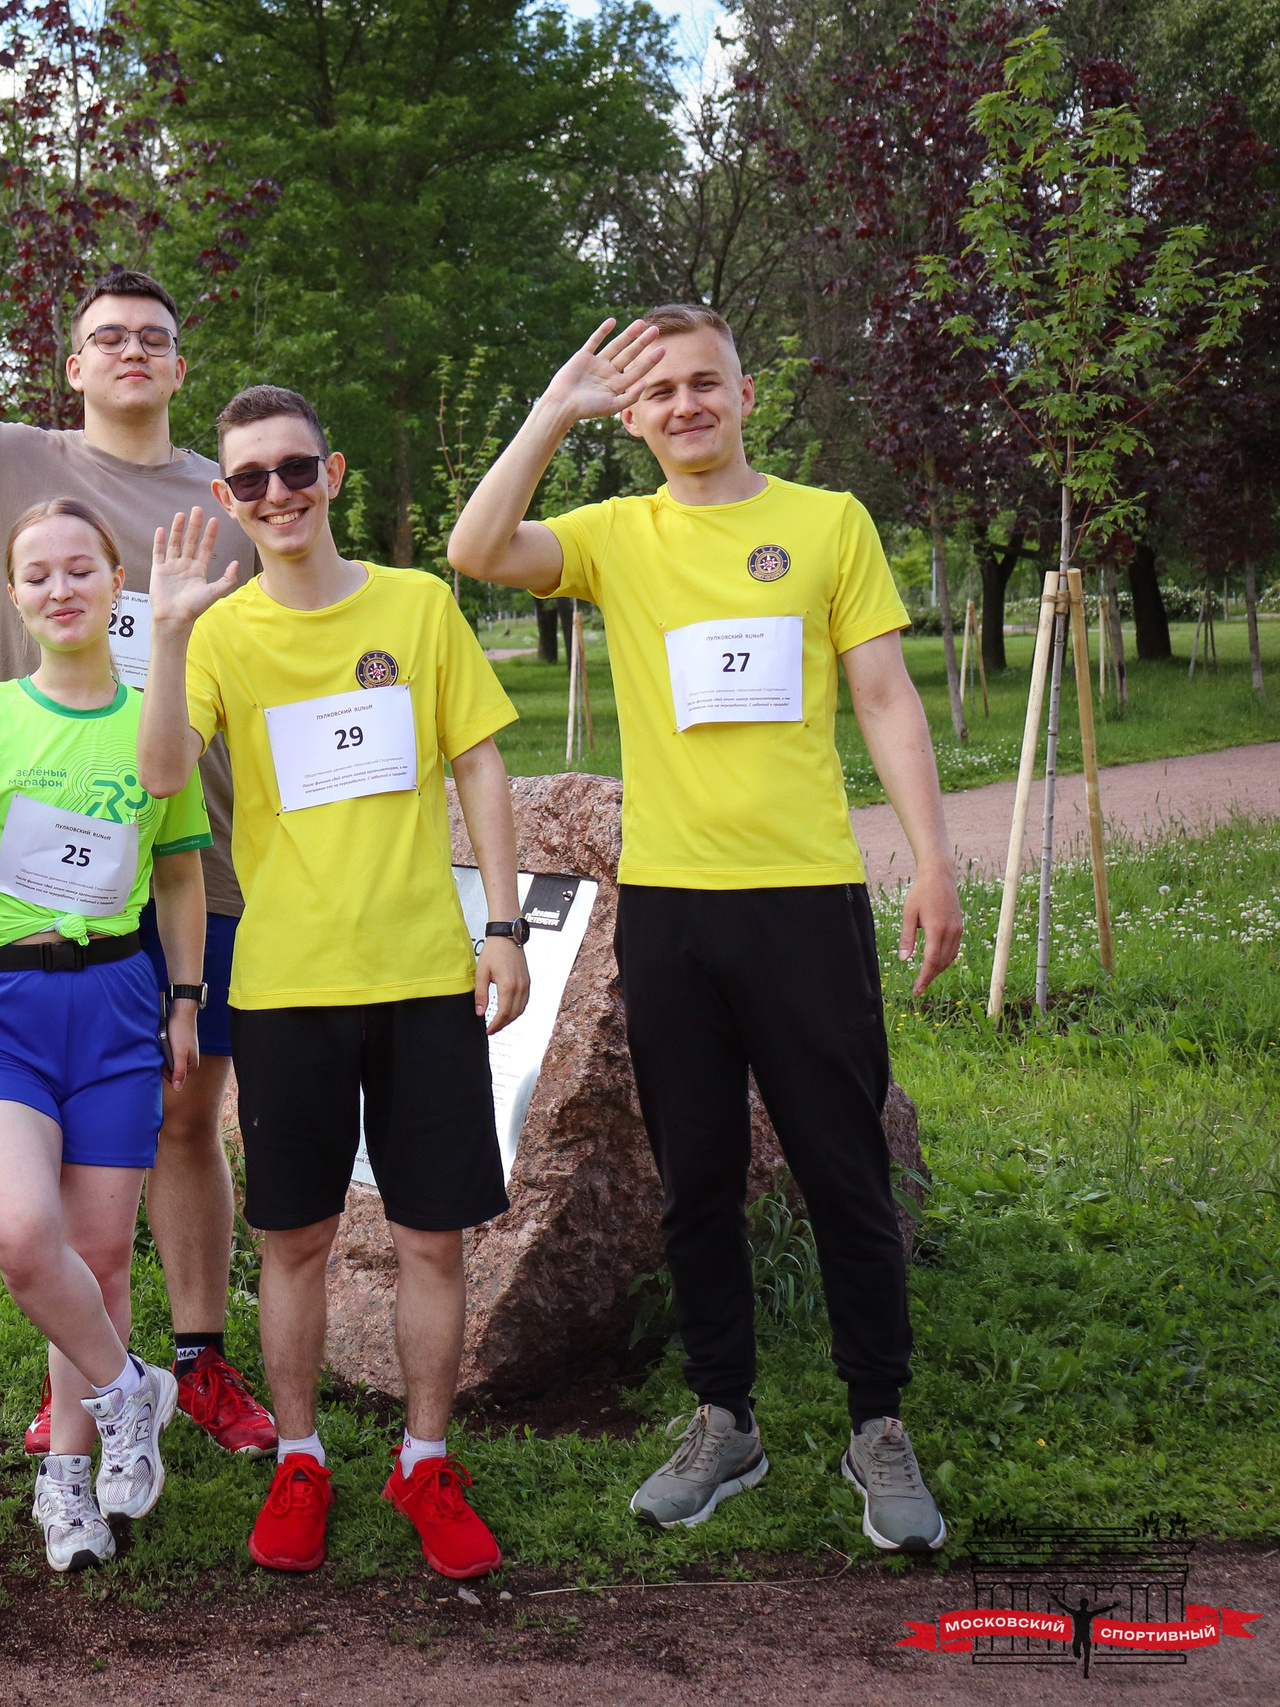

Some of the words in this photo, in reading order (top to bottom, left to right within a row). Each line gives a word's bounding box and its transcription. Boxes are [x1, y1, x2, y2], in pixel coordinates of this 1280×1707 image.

[108, 612, 135, 638] 28
[706, 633, 743, 642] ПУЛКОВСКИЙ
[745, 632, 765, 640] RUNoff
[722, 652, 751, 673] 27
[316, 707, 353, 721] ПУЛКОВСКИЙ
[354, 704, 373, 712] RUNoff
[334, 725, 364, 750] 29
[16, 766, 67, 778] зелёный
[8, 776, 63, 789] марафон
[55, 822, 91, 836] ПУЛКОВСКИЙ
[93, 832, 112, 841] RUNoff
[61, 844, 92, 867] 25
